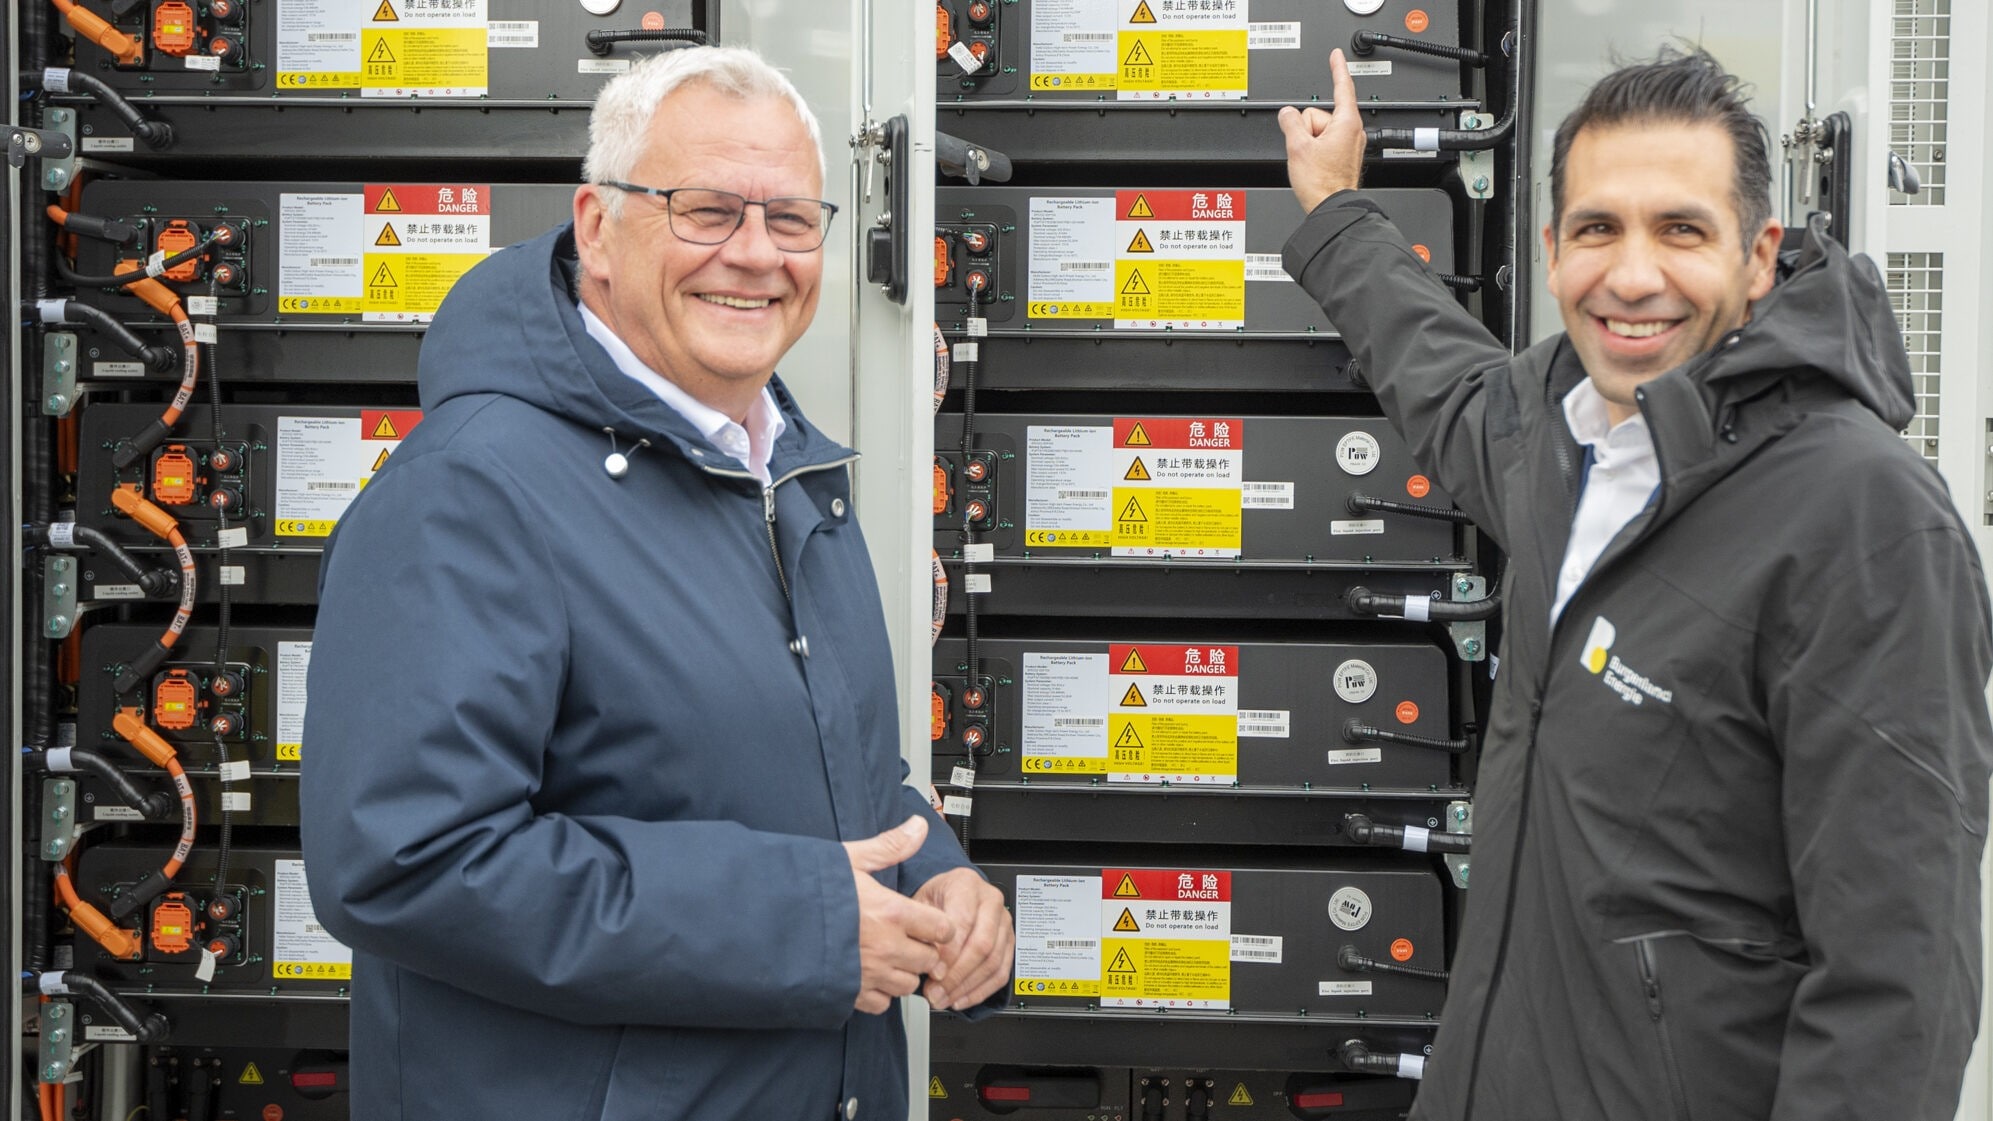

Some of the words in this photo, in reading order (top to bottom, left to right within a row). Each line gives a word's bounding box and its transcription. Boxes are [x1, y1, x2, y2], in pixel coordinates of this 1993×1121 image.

[281, 74, 295, 84] CE
[1034, 76, 1049, 86] CE
[438, 204, 478, 212] DANGER
[1193, 210, 1233, 218] DANGER
[407, 224, 478, 234] 禁止带载操作
[1160, 230, 1232, 241] 禁止带载操作
[283, 299, 297, 309] CE
[1032, 304, 1046, 314] CE
[1190, 439, 1230, 447] DANGER
[1157, 458, 1230, 469] 禁止带载操作
[279, 522, 293, 532] CE
[1030, 532, 1044, 543] CE
[1185, 665, 1226, 674] DANGER
[1153, 684, 1226, 696] 禁止带载操作
[1603, 670, 1643, 705] Energie
[281, 746, 295, 756] CE
[1026, 759, 1040, 769] CE
[1178, 891, 1218, 899] DANGER
[1146, 910, 1218, 921] 禁止带载操作
[278, 964, 292, 975] CE
[1019, 981, 1033, 991] CE
